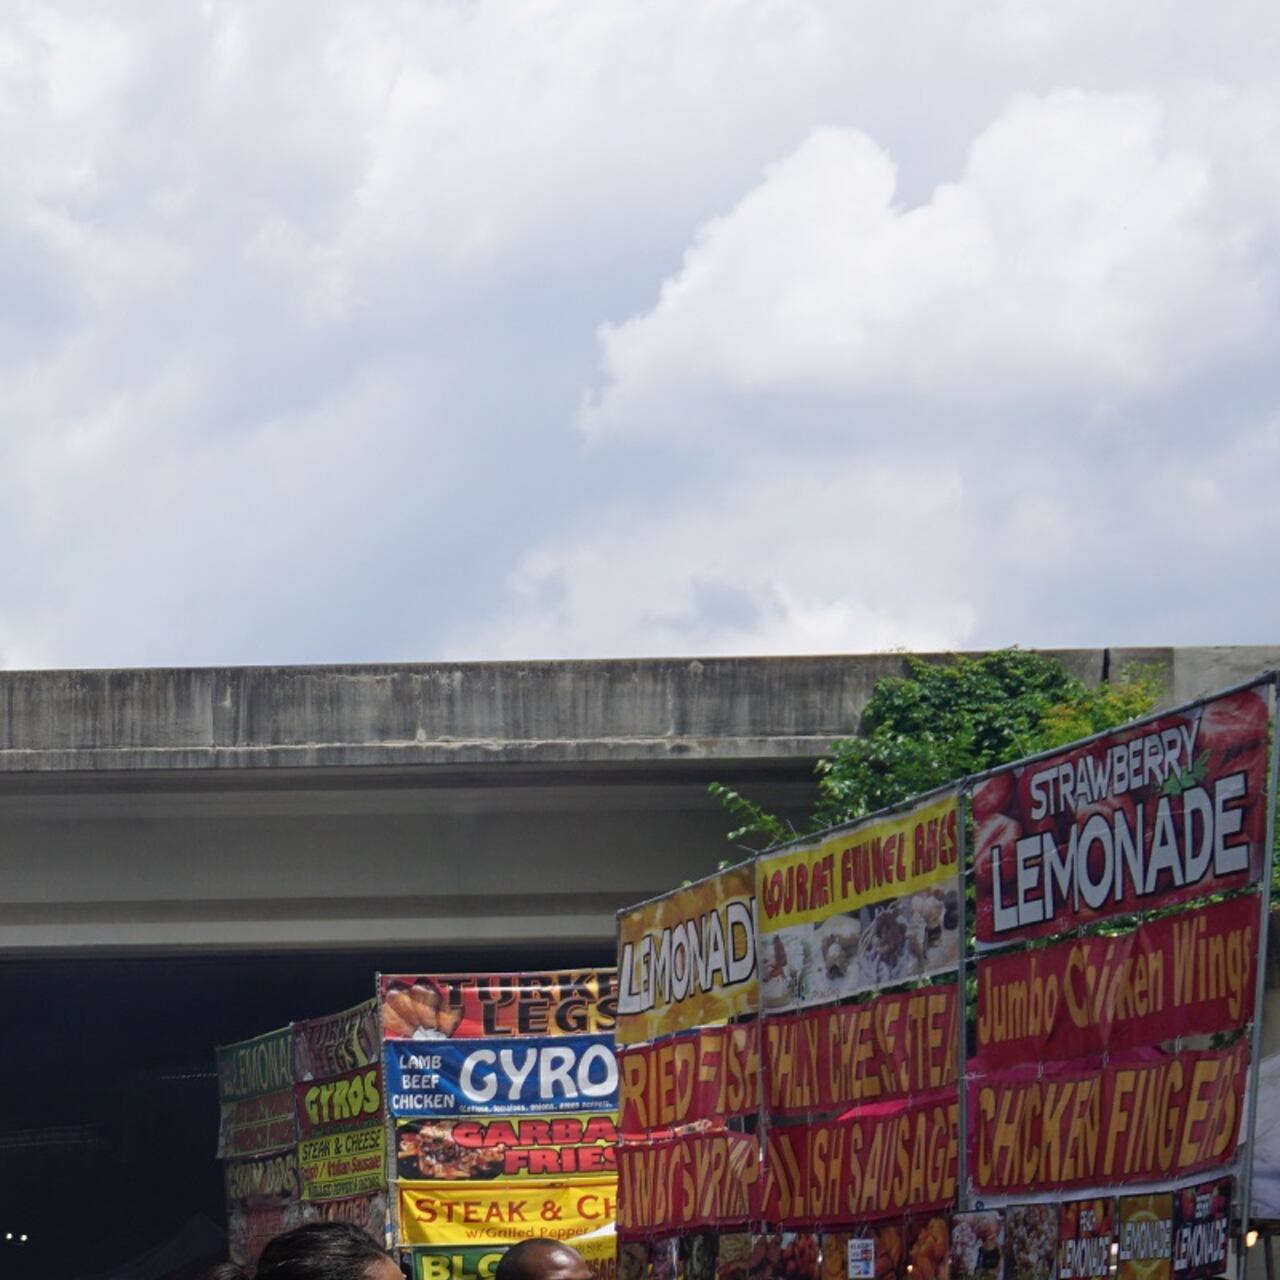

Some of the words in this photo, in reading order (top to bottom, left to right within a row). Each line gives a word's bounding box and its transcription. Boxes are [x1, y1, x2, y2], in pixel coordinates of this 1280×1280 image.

[1030, 718, 1200, 821] STRAWBERRY
[991, 773, 1250, 935] LEMONADE
[617, 897, 760, 1015] LEMONAD
[978, 959, 1060, 1045] Jumbo
[1172, 916, 1252, 1020] Wings
[483, 997, 618, 1035] LEGS
[399, 1055, 442, 1070] LAMB
[402, 1074, 440, 1089] BEEF
[304, 1070, 380, 1125] GYROS
[393, 1093, 455, 1109] CHICKEN
[303, 1140, 330, 1160] STEAK
[335, 1137, 342, 1154] &
[345, 1129, 382, 1152] CHEESE
[415, 1199, 528, 1223] STEAK
[540, 1200, 562, 1221] &
[1120, 1219, 1172, 1260] LEMONADE
